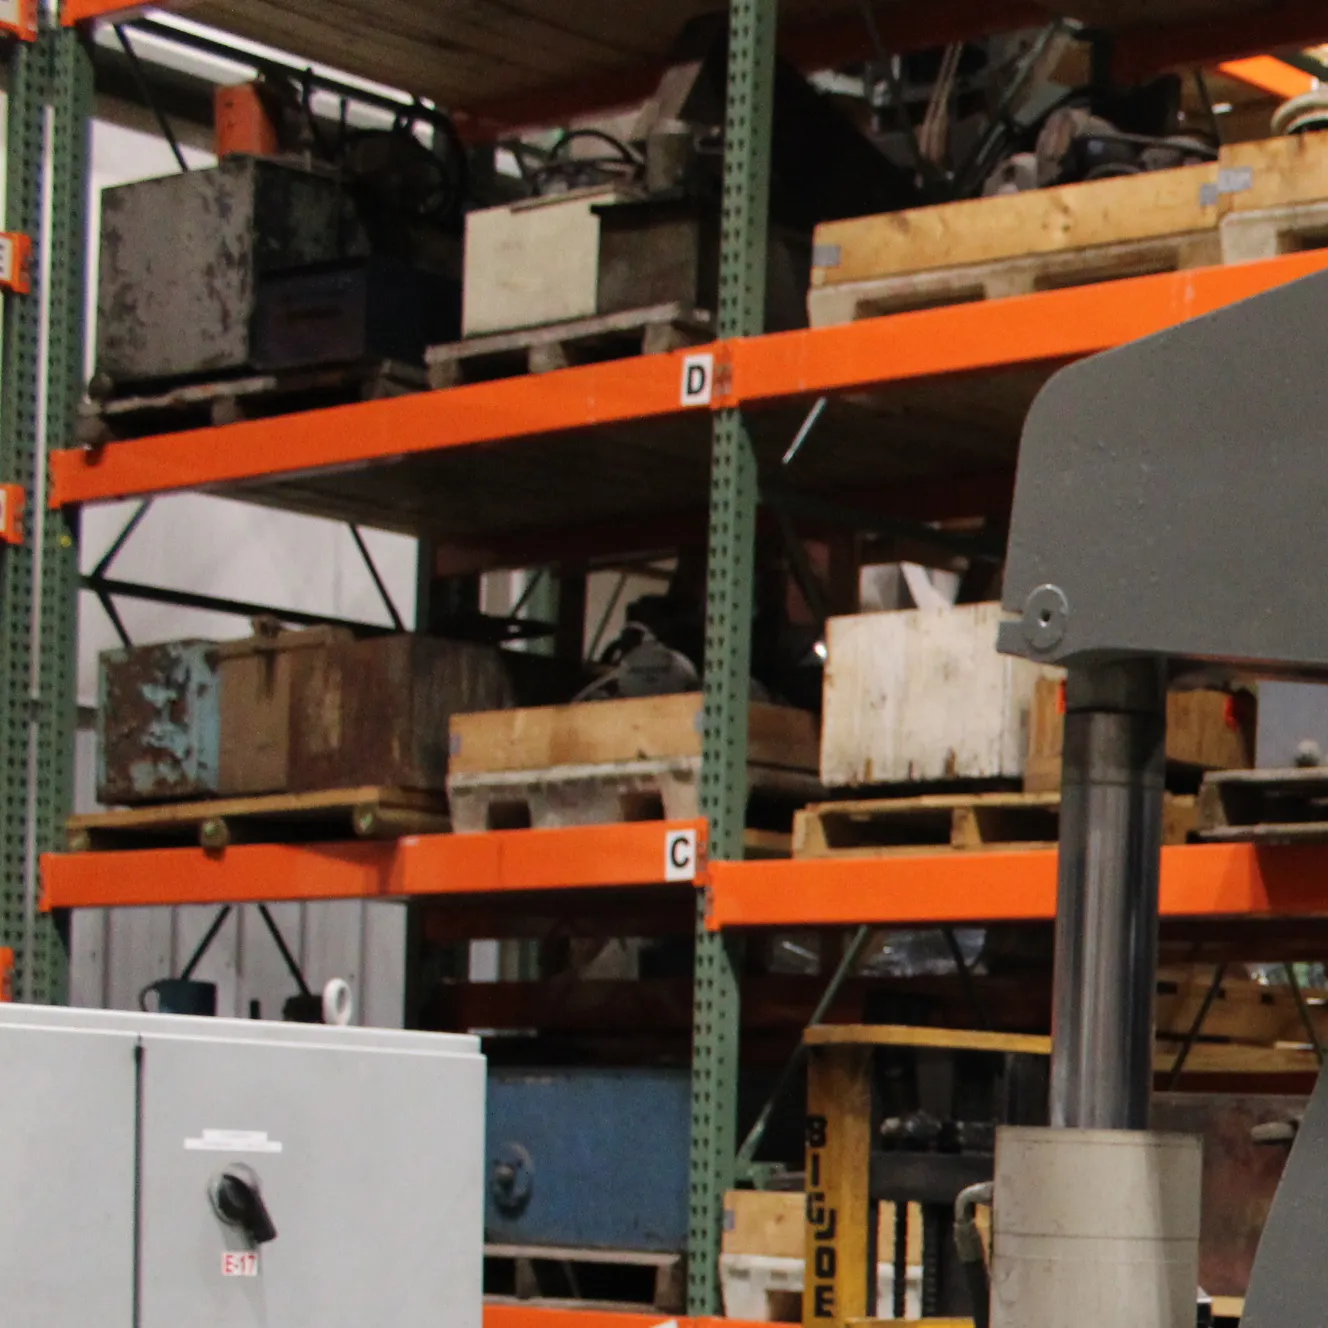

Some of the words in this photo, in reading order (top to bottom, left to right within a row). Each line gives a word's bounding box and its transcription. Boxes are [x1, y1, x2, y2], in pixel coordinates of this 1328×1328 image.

[686, 365, 706, 395] D
[671, 837, 689, 868] C
[806, 1115, 828, 1225] BIG
[223, 1254, 257, 1274] E-17
[814, 1208, 837, 1318] JOE
